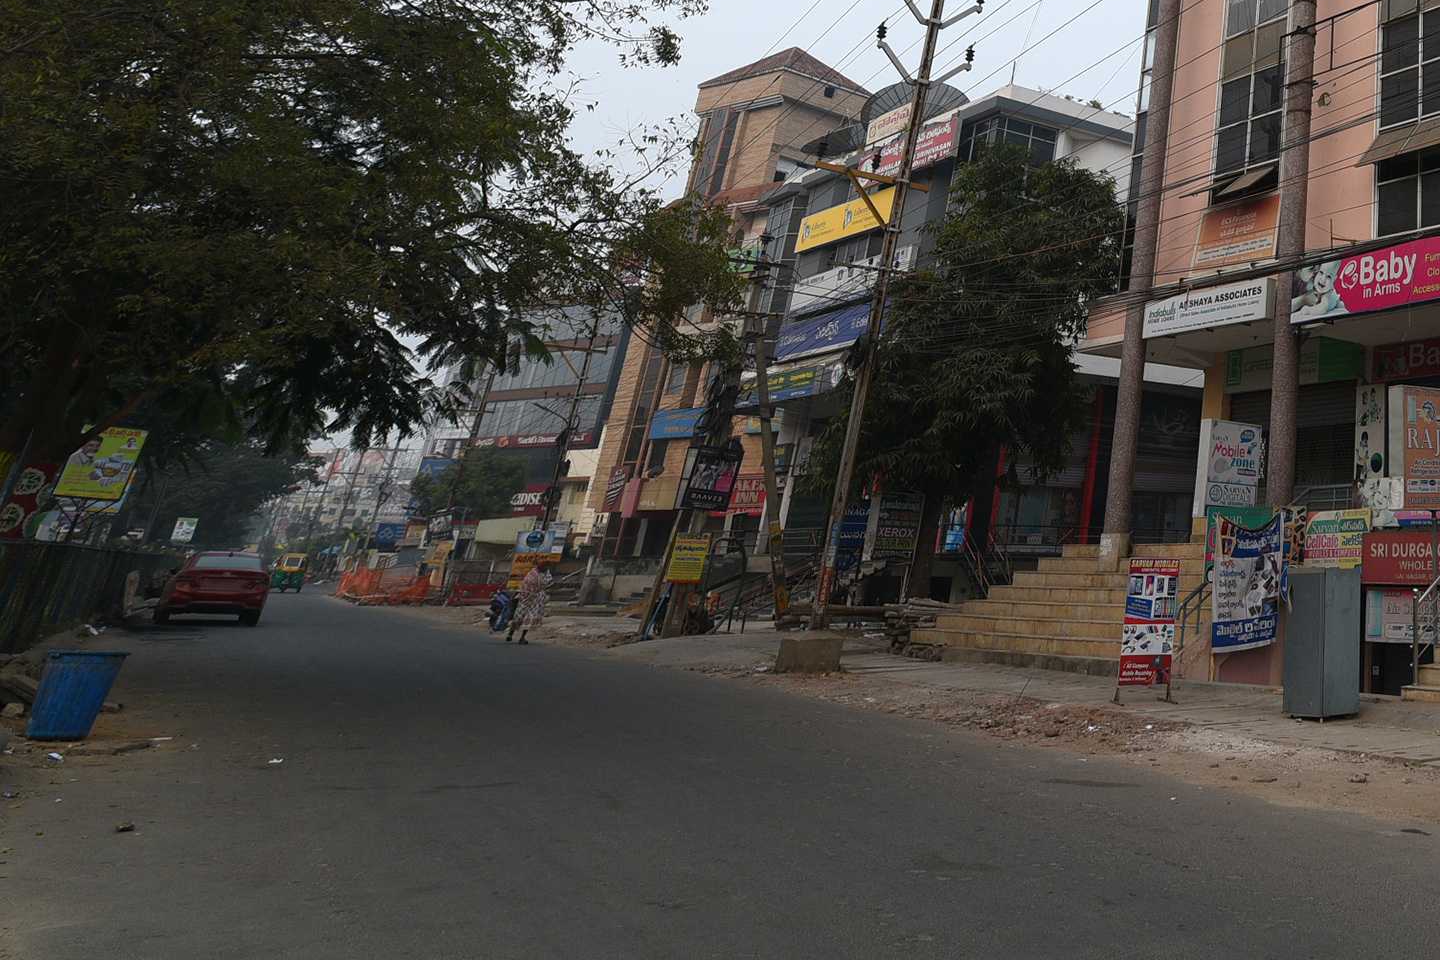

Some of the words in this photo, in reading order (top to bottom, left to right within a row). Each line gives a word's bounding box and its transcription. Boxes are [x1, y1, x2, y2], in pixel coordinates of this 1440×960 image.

[1359, 250, 1417, 285] Baby
[1215, 286, 1262, 303] ASSOCIATES
[1363, 286, 1372, 298] in
[1374, 282, 1401, 296] Arms
[879, 527, 915, 538] XEROX
[1370, 543, 1388, 558] SRI
[1391, 543, 1433, 558] DURGA
[1401, 561, 1433, 571] WHOLE
